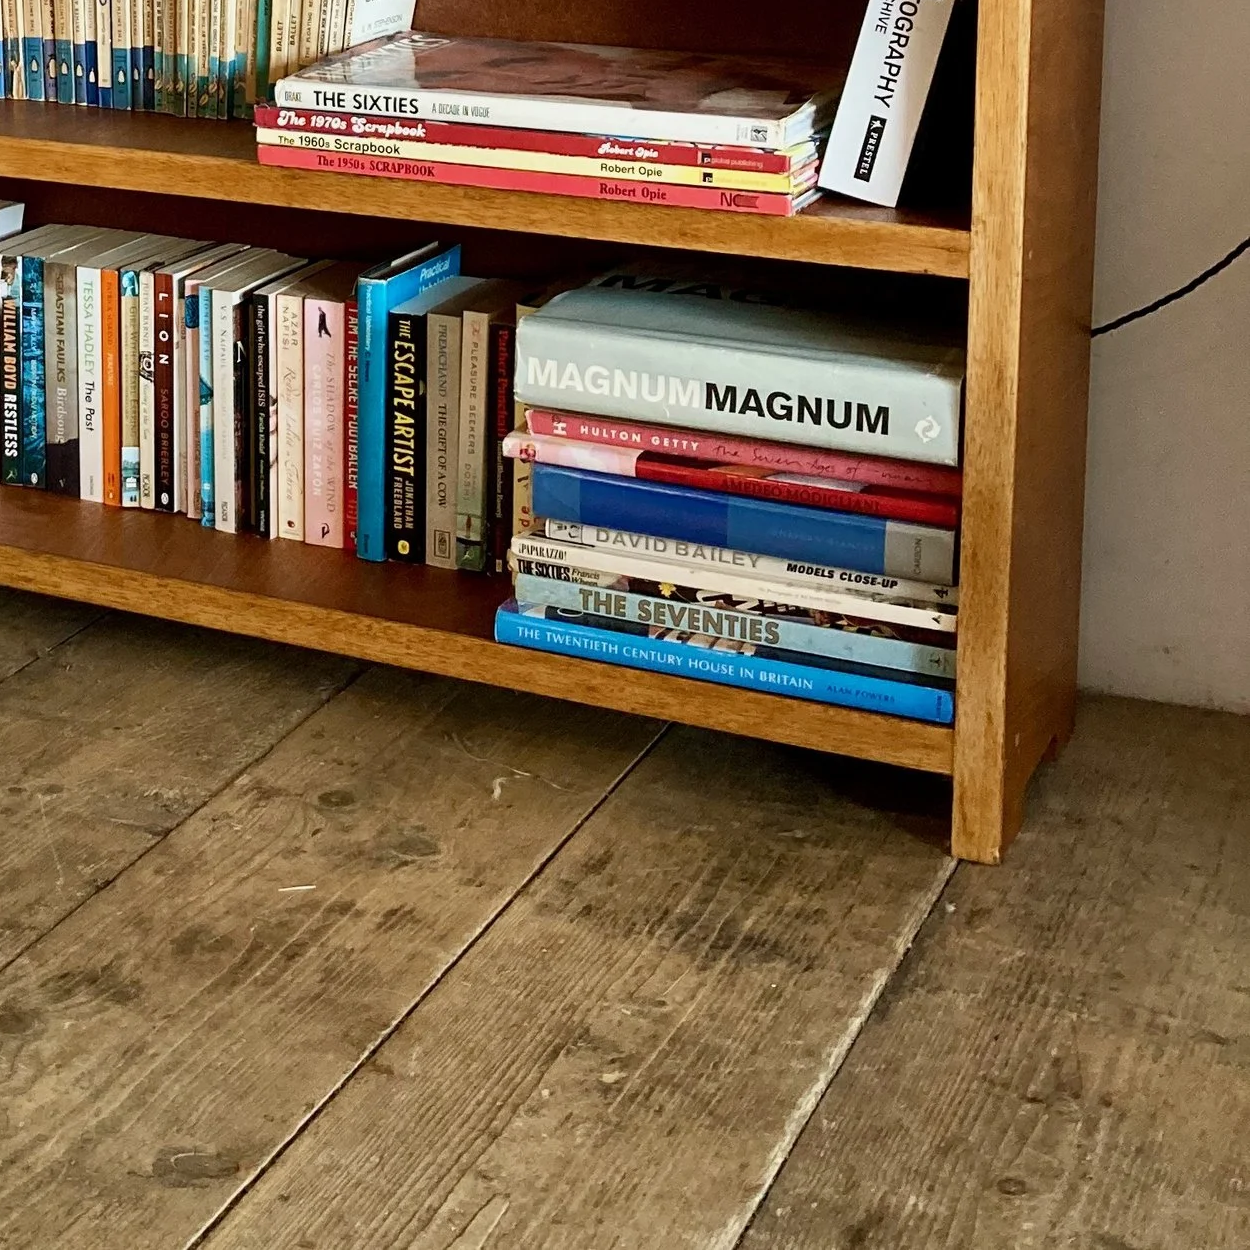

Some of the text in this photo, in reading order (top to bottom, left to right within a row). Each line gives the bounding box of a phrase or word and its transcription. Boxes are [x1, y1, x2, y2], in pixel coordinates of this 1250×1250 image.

[289, 13, 297, 46] BALLET
[284, 90, 491, 119] DRAKE THE SIXTIES A DECADE IN VOGUE
[277, 110, 659, 160] The 1970s Scrapbook Robert Opie
[278, 135, 663, 178] The 1960s Scrapbook Robert Opie
[859, 130, 880, 176] PRESTEL
[317, 155, 667, 201] The 1950s SCRAPBOOK Robert Opie
[420, 255, 451, 283] Practical
[256, 319, 265, 335] girl
[257, 304, 265, 319] the
[281, 305, 290, 351] NAFISI
[290, 311, 299, 347] AZAR
[54, 273, 68, 444] SEBASTIAN FAULKS Birdsong
[83, 281, 95, 432] TESSA HADLEY The Past
[257, 335, 265, 354] who
[437, 323, 448, 398] PREMCHAND
[2, 299, 18, 458] WILLIAM BOYD RESTLESS
[158, 292, 170, 487] LION SAROO BRIERLEY
[257, 355, 266, 388] escaped
[258, 389, 266, 407] ISIS
[326, 376, 336, 434] SHADOW
[393, 319, 416, 477] THE ESCAPE ARTIST
[437, 404, 447, 427] THE
[466, 341, 479, 455] PLEASURE SEEKERS
[527, 356, 890, 436] MAGNUM MAGNUM
[437, 428, 447, 454] GIFT
[580, 424, 700, 452] HULTON GETTY
[437, 455, 447, 471] OF
[326, 477, 336, 513] WIND
[393, 476, 403, 530] FREEDLAND
[404, 479, 414, 530] JONATHAN
[437, 482, 447, 509] COW
[721, 476, 880, 514] AMEDEO MODIGLIANI
[516, 558, 572, 583] THE SIXTIES
[571, 568, 601, 582] Francis
[596, 527, 899, 590] DAVID BAILEY MODELS CLOSE-UP
[578, 588, 781, 645] THE SEVENTIES
[516, 625, 896, 703] THE TWENTIETH CENTURY HOUSE IN BRITAIN ALAN POWERS
